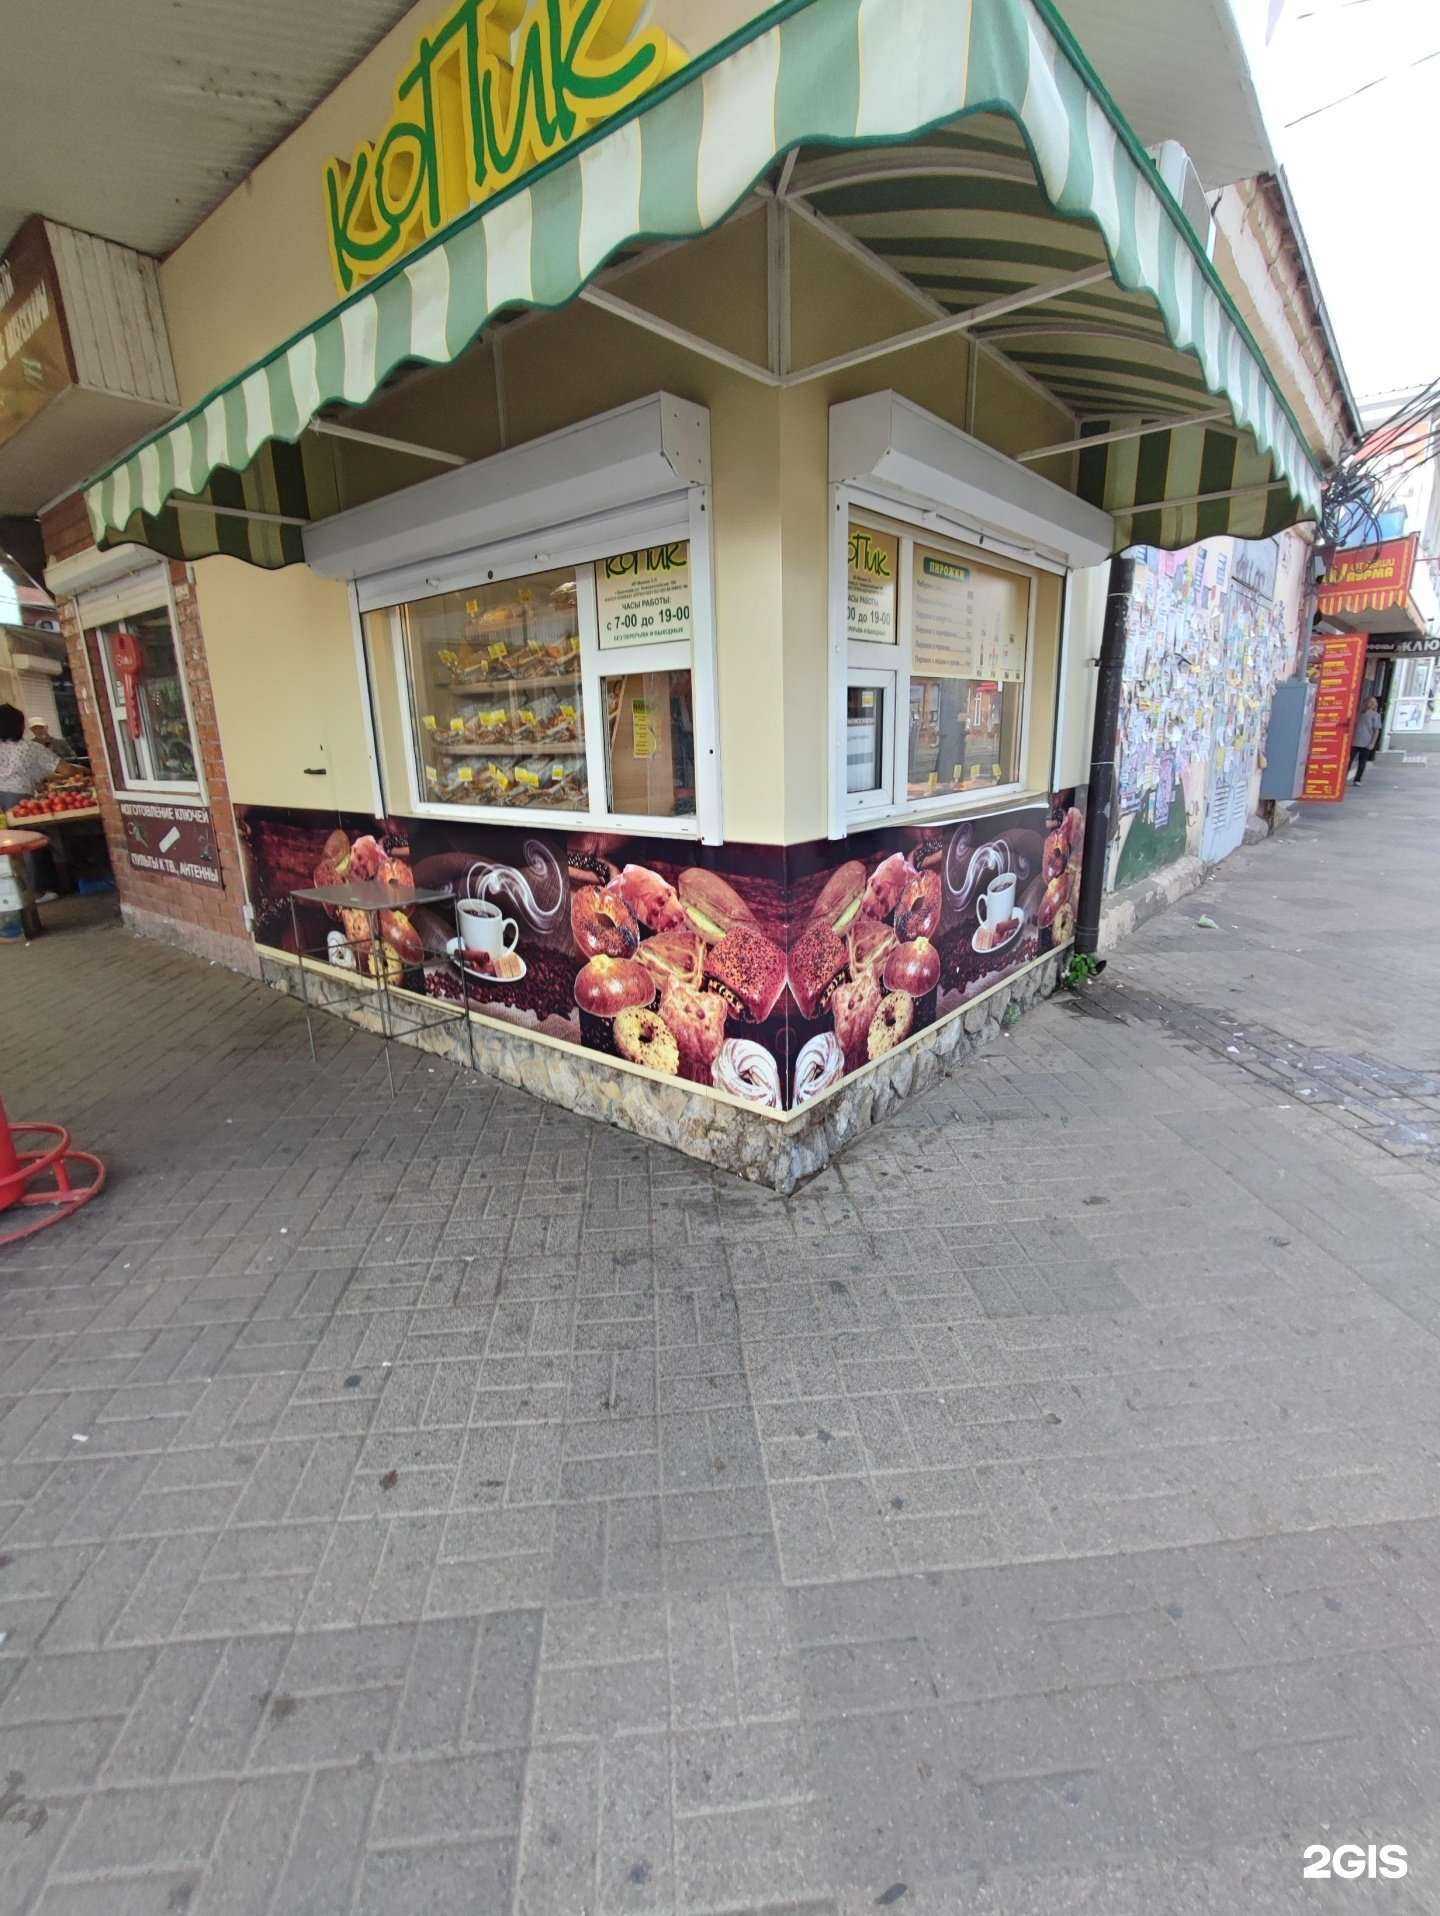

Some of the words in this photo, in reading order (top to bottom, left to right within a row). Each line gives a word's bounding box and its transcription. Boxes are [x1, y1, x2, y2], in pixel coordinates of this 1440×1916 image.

[848, 533, 890, 576] ОПИК
[622, 601, 641, 610] ЧАСЫ
[642, 597, 671, 607] РАБОТЫ:
[614, 614, 638, 629] 7-00
[641, 617, 654, 627] до
[659, 606, 690, 623] 19-00
[174, 808, 209, 823] КЛЮЧЕЙ
[180, 862, 218, 882] АНТЕННЫ
